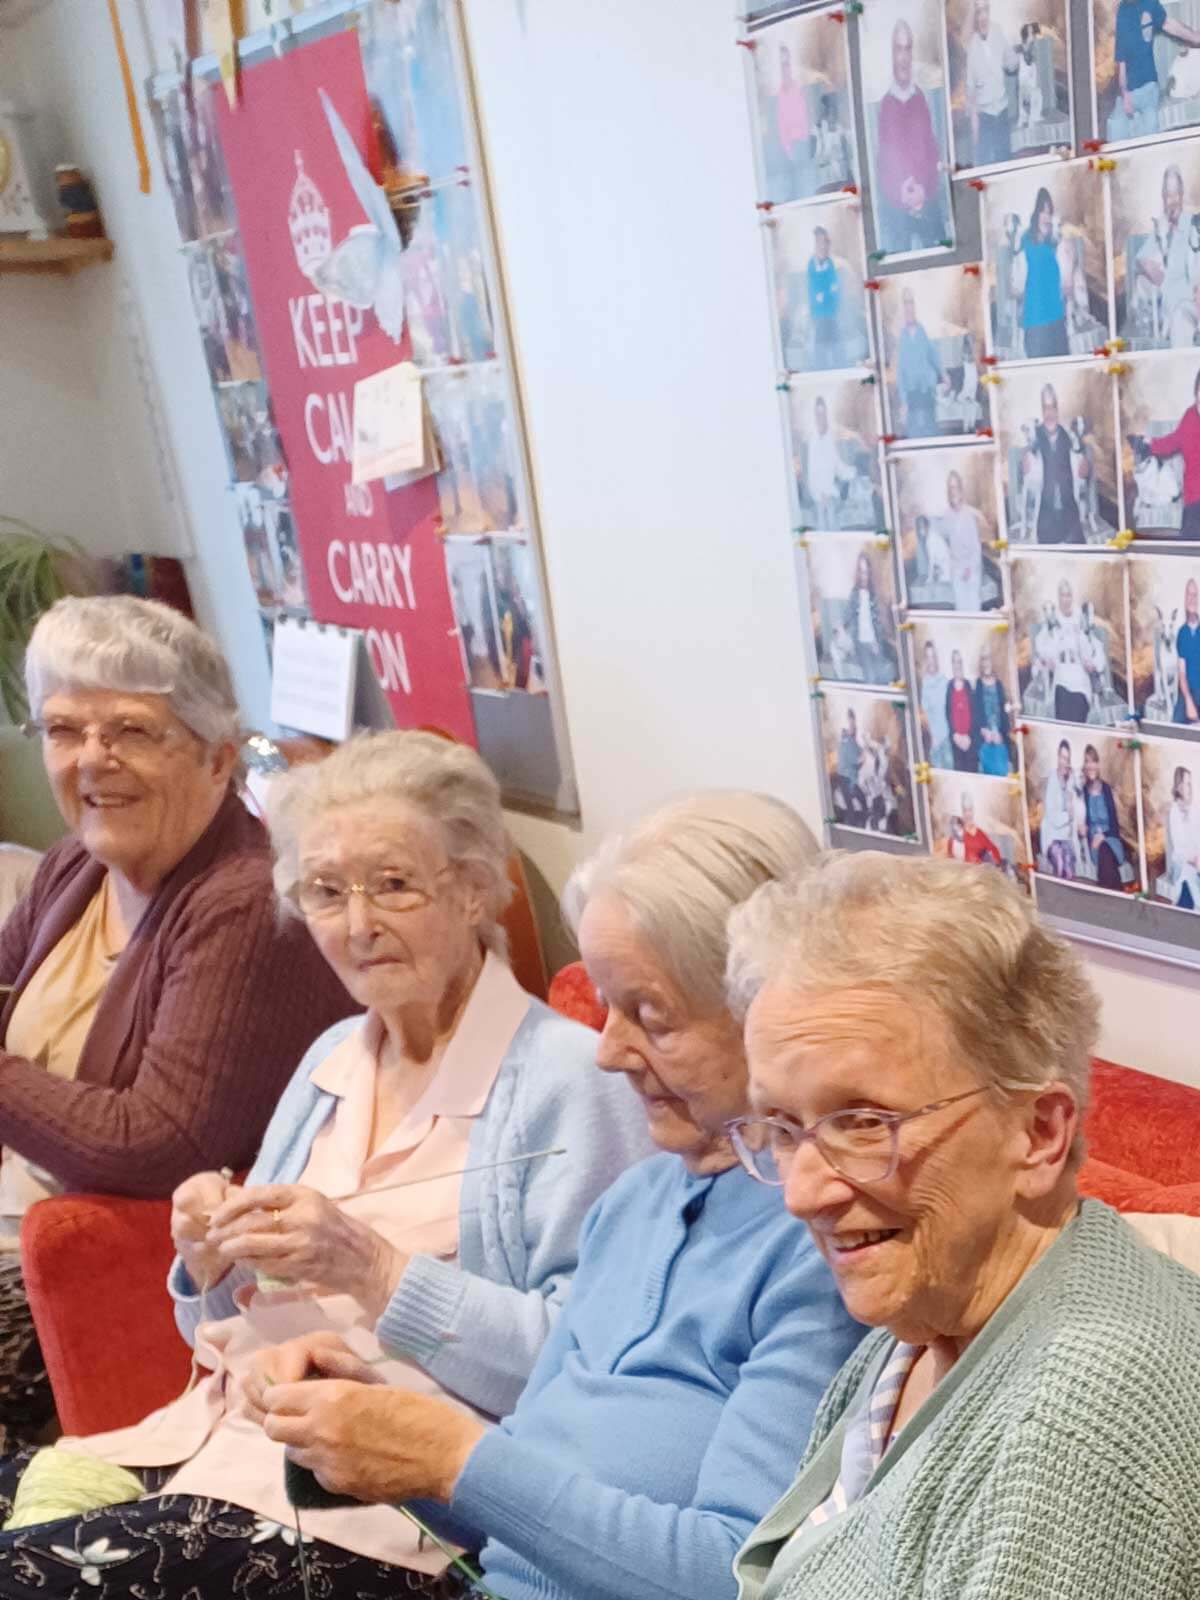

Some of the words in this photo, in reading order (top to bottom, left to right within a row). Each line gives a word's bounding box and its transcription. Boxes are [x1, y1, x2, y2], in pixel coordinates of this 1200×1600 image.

[288, 293, 364, 368] KEEP
[327, 539, 417, 609] CARRY
[366, 626, 412, 694] ON
